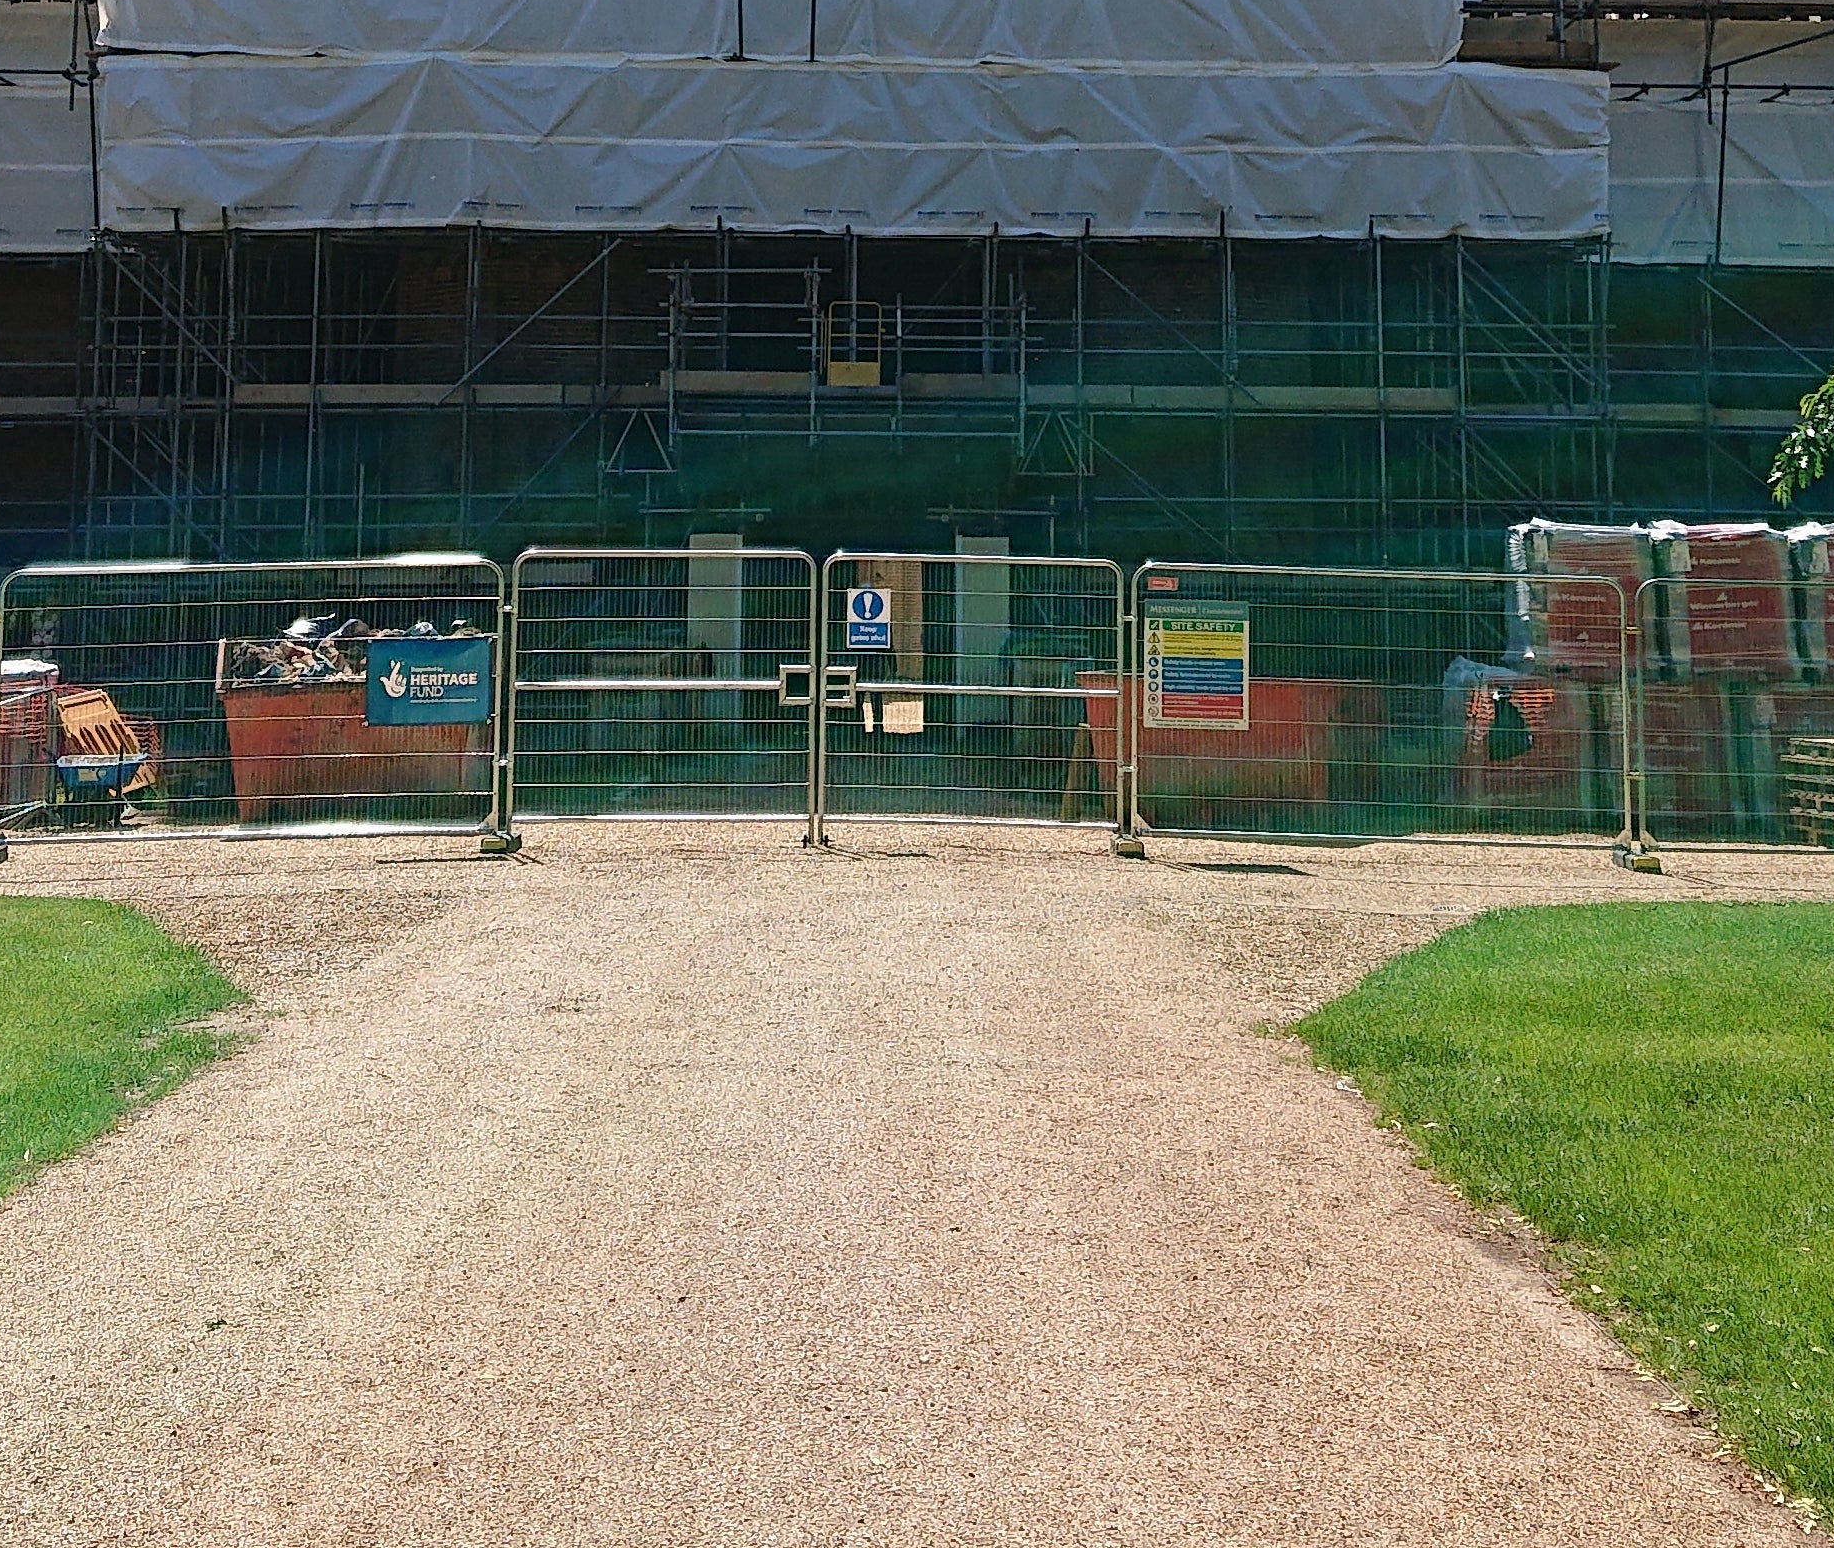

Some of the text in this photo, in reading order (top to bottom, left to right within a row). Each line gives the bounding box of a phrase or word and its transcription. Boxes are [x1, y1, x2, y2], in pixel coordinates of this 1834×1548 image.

[1171, 622, 1235, 631] SITE SAFETY
[411, 673, 478, 685] HERITAGE
[410, 686, 444, 697] FUND
